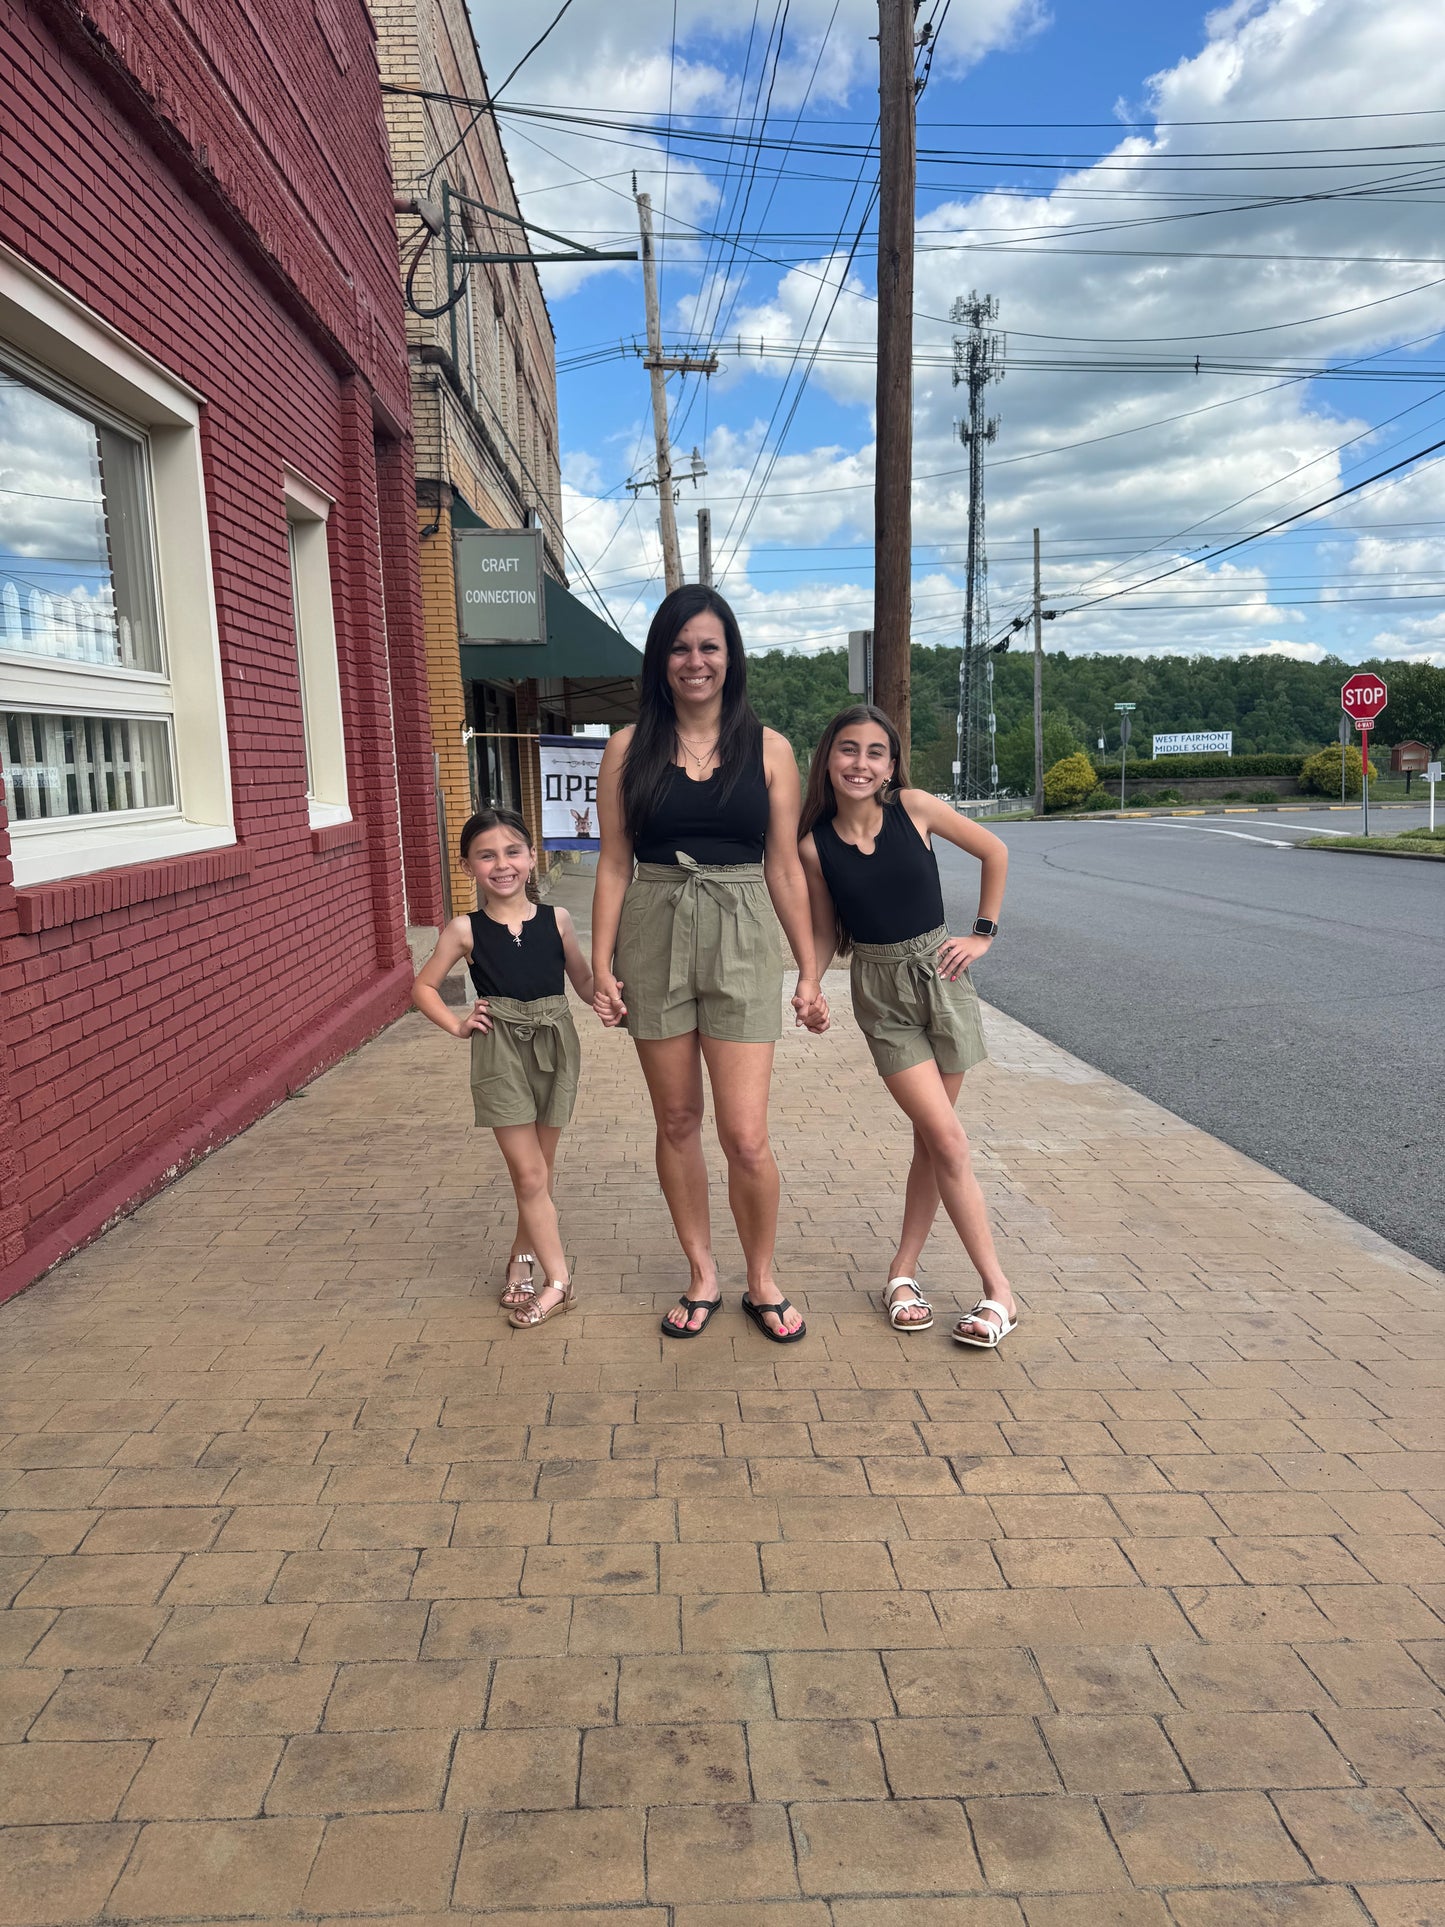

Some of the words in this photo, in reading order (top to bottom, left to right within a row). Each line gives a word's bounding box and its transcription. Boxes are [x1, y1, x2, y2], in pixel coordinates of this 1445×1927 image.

[481, 558, 519, 572] CRAFT
[465, 590, 536, 604] CONNECTION
[1345, 687, 1384, 706] STOP
[1155, 735, 1178, 743] WEST
[1181, 733, 1230, 742] FAIRMONT
[1155, 744, 1189, 752] MIDDLE
[1191, 743, 1230, 751] SCHOOL
[545, 774, 598, 802] OPE
